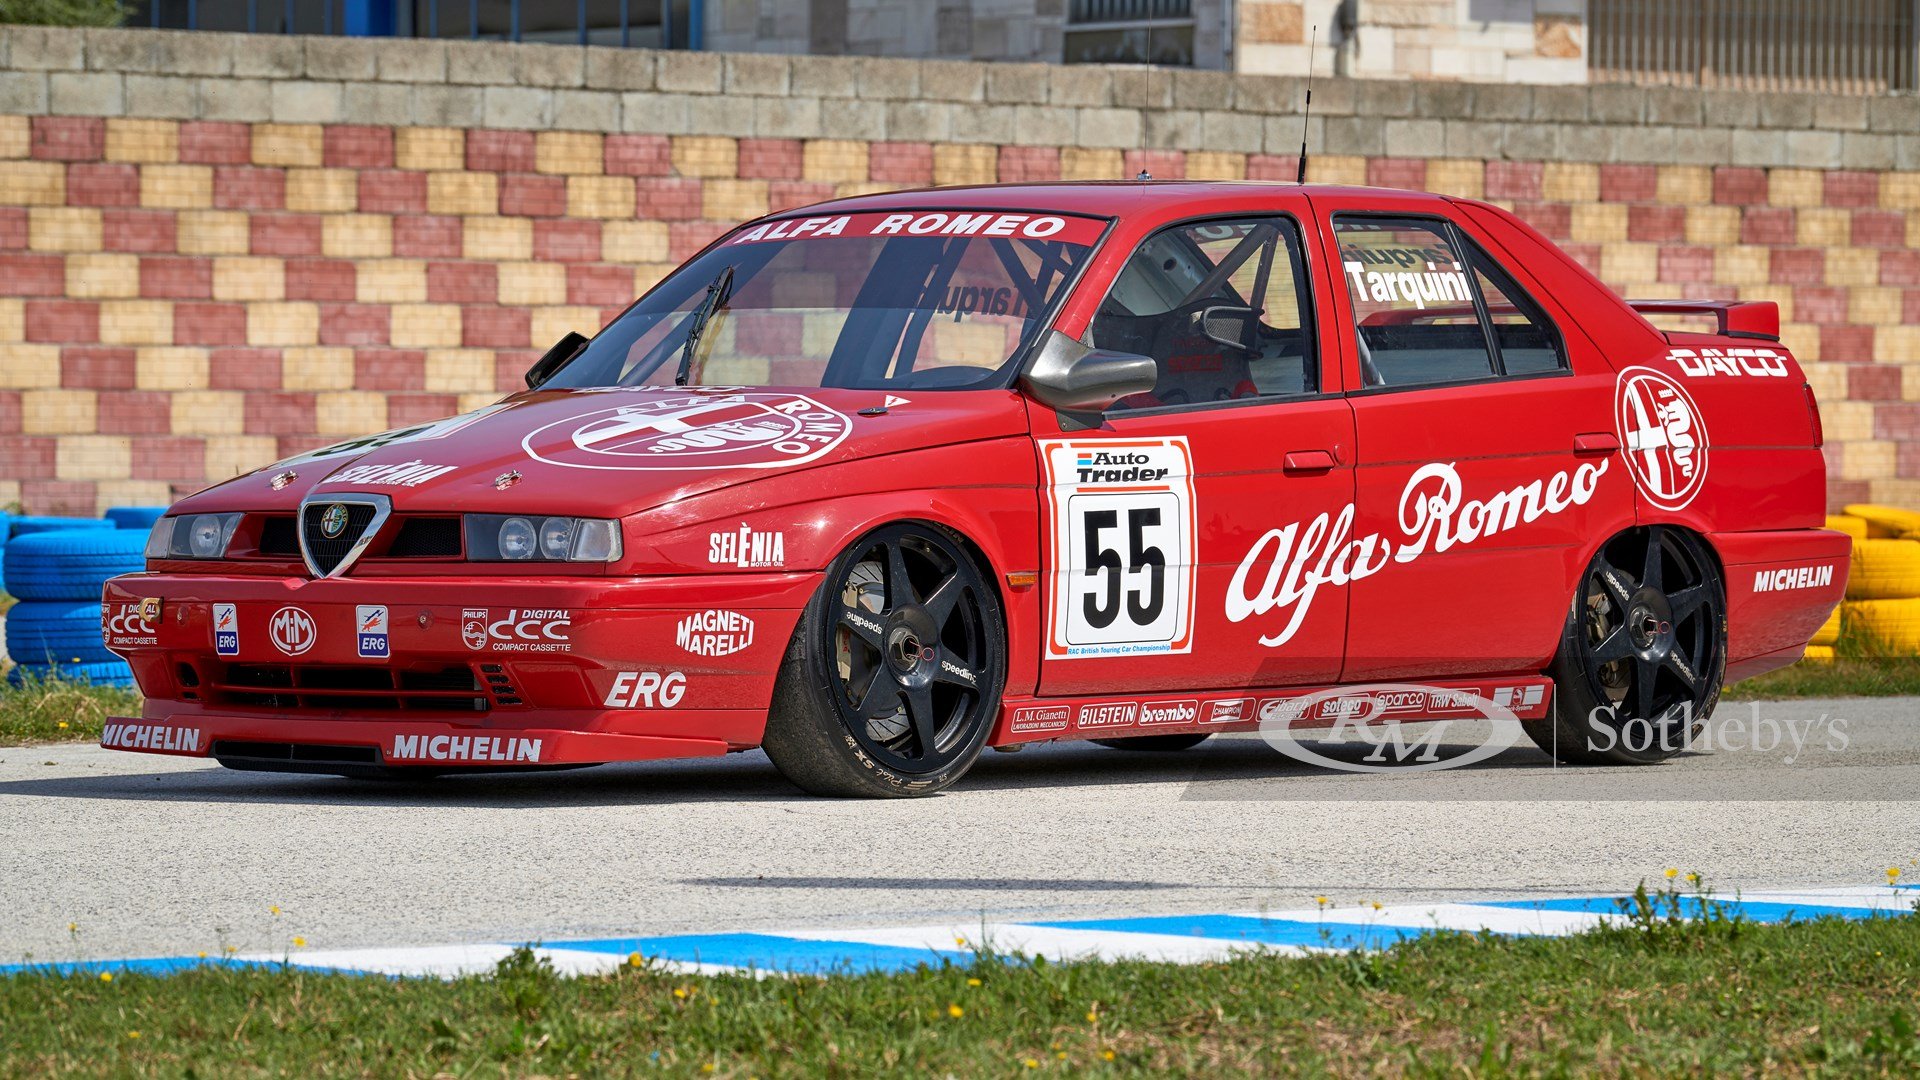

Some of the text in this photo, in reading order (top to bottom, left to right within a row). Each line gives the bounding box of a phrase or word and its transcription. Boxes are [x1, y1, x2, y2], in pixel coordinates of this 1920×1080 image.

[734, 213, 1066, 245] ALFA ROMEO
[1344, 261, 1473, 310] Tarquini
[1665, 348, 1788, 377] DAYCO
[617, 394, 746, 416] ALFA
[772, 400, 842, 454] ROMEO
[1092, 452, 1150, 466] Auto
[1077, 468, 1168, 483] Trader
[708, 522, 785, 568] SELÈNIA
[1225, 458, 1609, 647] Alfa Romeo
[1083, 507, 1166, 629] 55
[1753, 565, 1834, 593] MICHELIN
[463, 611, 486, 619] PHILIPS
[521, 609, 571, 619] DIGITAL
[676, 609, 754, 639] MAGNETI
[846, 611, 883, 635] speedline
[488, 609, 571, 640] dcc
[113, 637, 157, 645] COMPACT CASSETTE
[219, 635, 236, 648] ERG
[361, 637, 386, 650] ERG
[492, 643, 572, 652] COMPACT CASSETTE
[676, 627, 754, 657] MARELLI
[1100, 646, 1120, 654] Touring
[1121, 645, 1131, 653] Car
[1132, 644, 1171, 652] Championship
[603, 671, 687, 709] ERG
[1377, 692, 1425, 708] sparco
[1322, 696, 1361, 714] soteco
[1430, 693, 1450, 709] TRW
[1450, 692, 1479, 708] Sabelt
[1036, 709, 1067, 721] Gianetti
[1080, 705, 1136, 726] BILSTEIN
[1140, 703, 1195, 723] brembo
[1213, 706, 1241, 716] CHAMPION
[1040, 721, 1067, 729] MECCANICHE
[102, 724, 200, 752] MICHELIN
[393, 734, 543, 763] MICHELIN
[854, 749, 875, 769] SX
